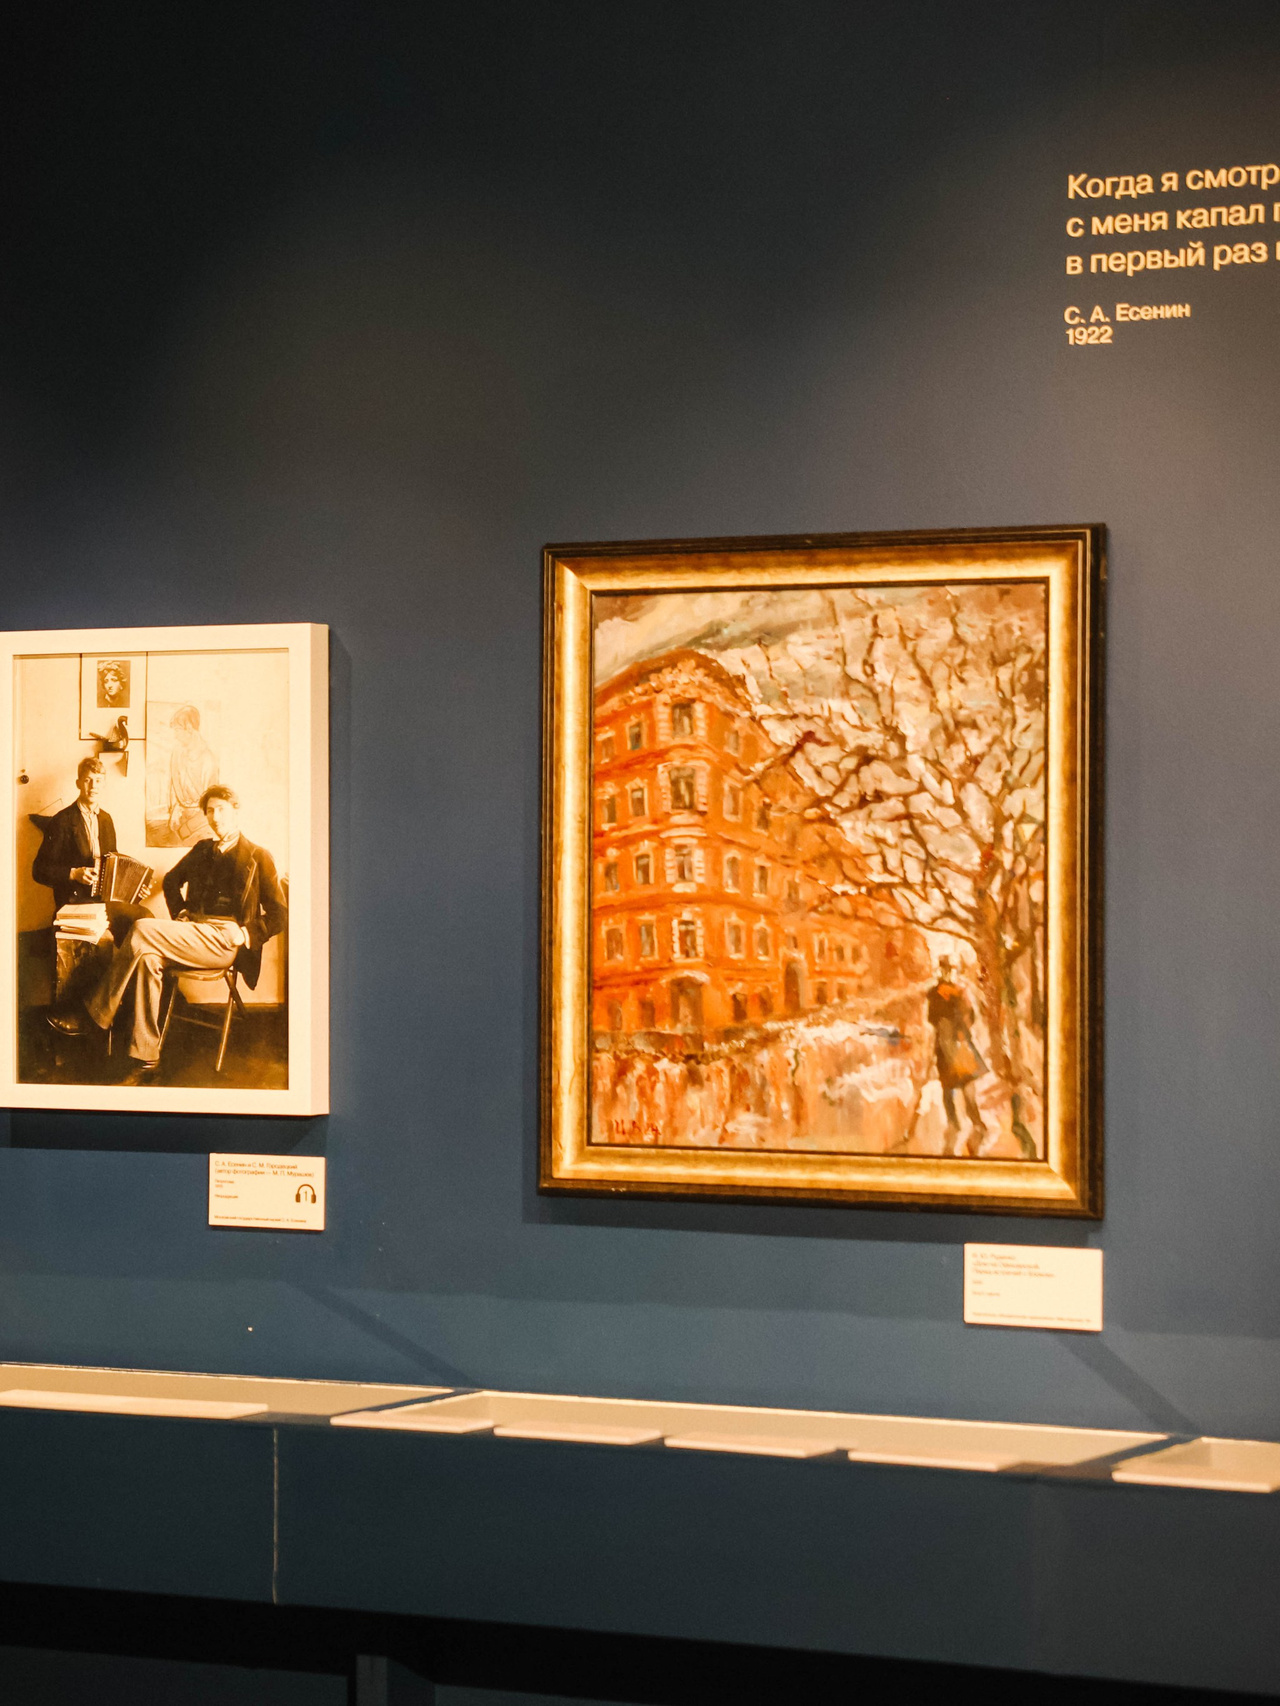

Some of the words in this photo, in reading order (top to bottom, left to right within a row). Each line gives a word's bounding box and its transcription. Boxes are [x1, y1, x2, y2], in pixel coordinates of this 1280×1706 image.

[1068, 173, 1154, 199] Когда
[1161, 172, 1179, 192] я
[1186, 163, 1280, 190] смотр
[1092, 211, 1168, 235] меня
[1176, 204, 1265, 229] капал
[1273, 202, 1280, 222] п
[1090, 241, 1205, 277] первый
[1213, 242, 1268, 271] раз
[1064, 306, 1086, 324] С.
